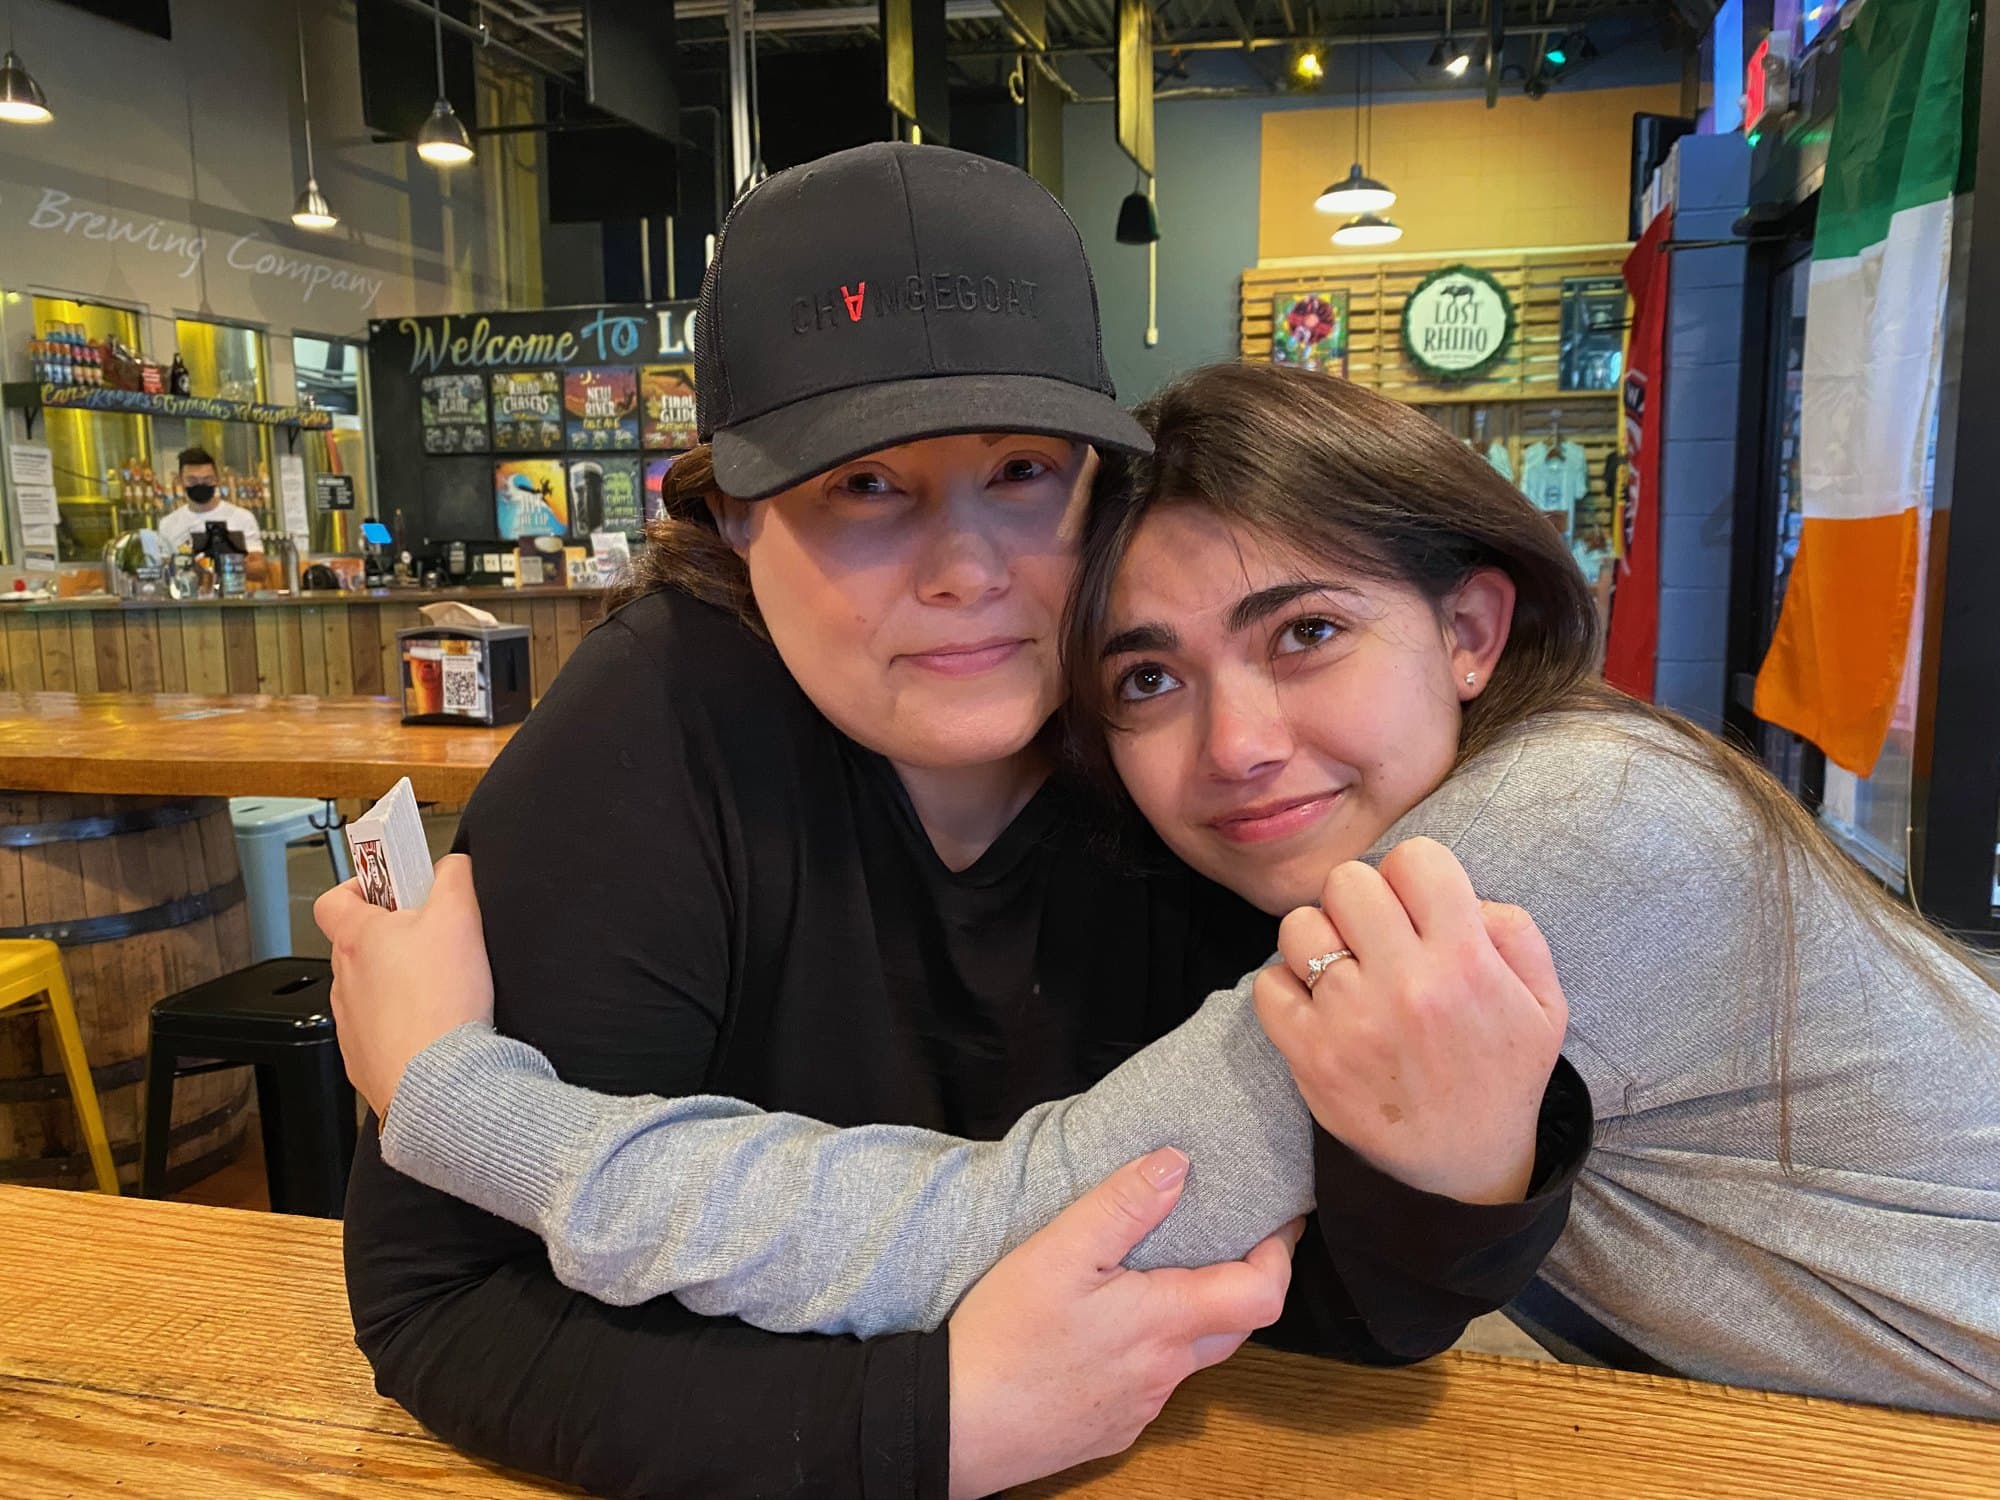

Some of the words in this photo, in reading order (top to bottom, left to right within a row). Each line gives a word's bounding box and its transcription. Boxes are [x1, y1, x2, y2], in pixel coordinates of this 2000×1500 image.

[29, 187, 207, 277] Brewing
[226, 232, 385, 310] Company
[1435, 301, 1484, 325] LOST
[399, 316, 579, 373] Welcome
[1424, 327, 1488, 352] RHINO
[503, 394, 549, 414] CHASERS
[587, 385, 612, 402] NEW
[661, 394, 696, 409] FINAL
[585, 401, 616, 417] RIVER
